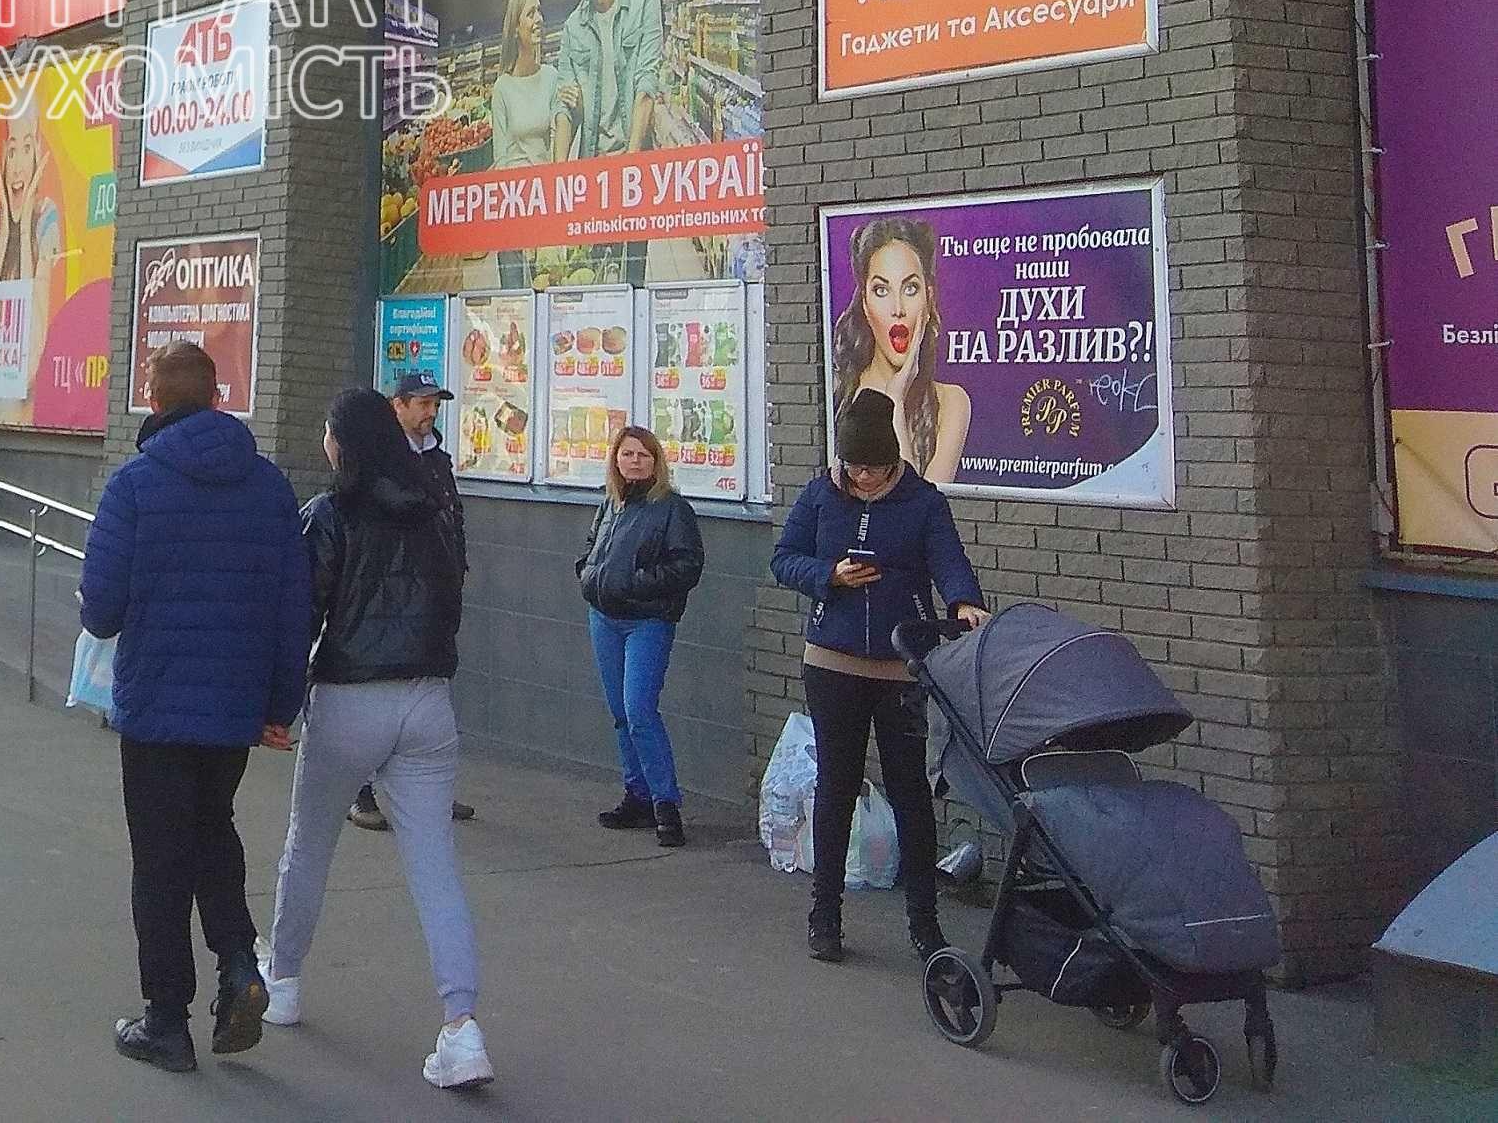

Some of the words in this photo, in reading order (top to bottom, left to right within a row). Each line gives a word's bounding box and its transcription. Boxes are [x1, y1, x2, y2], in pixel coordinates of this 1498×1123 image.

[177, 13, 234, 67] АТБ
[840, 21, 940, 57] Гаджети
[946, 15, 976, 39] та
[427, 176, 548, 227] МЕРЕЖА
[555, 174, 587, 214] №
[596, 170, 609, 209] 1
[622, 165, 643, 208] В
[651, 142, 765, 205] УКРАЇ
[567, 221, 582, 237] за
[584, 214, 647, 236] кількістю
[650, 208, 748, 233] торгівельних
[940, 235, 969, 257] Ты
[973, 236, 1011, 262] еще
[1014, 236, 1037, 253] не
[1042, 223, 1150, 251] пробовала
[175, 254, 253, 291] ОПТИКА
[1014, 259, 1071, 280] наши
[996, 285, 1085, 328] ДУХИ
[946, 330, 992, 364] НА
[997, 320, 1153, 364] РАЗЛИВ?!
[53, 355, 71, 394] ТЦ
[1021, 379, 1051, 437] PREMIER
[1053, 379, 1082, 437] PARFUM
[961, 455, 1115, 481] www.premierparfum
